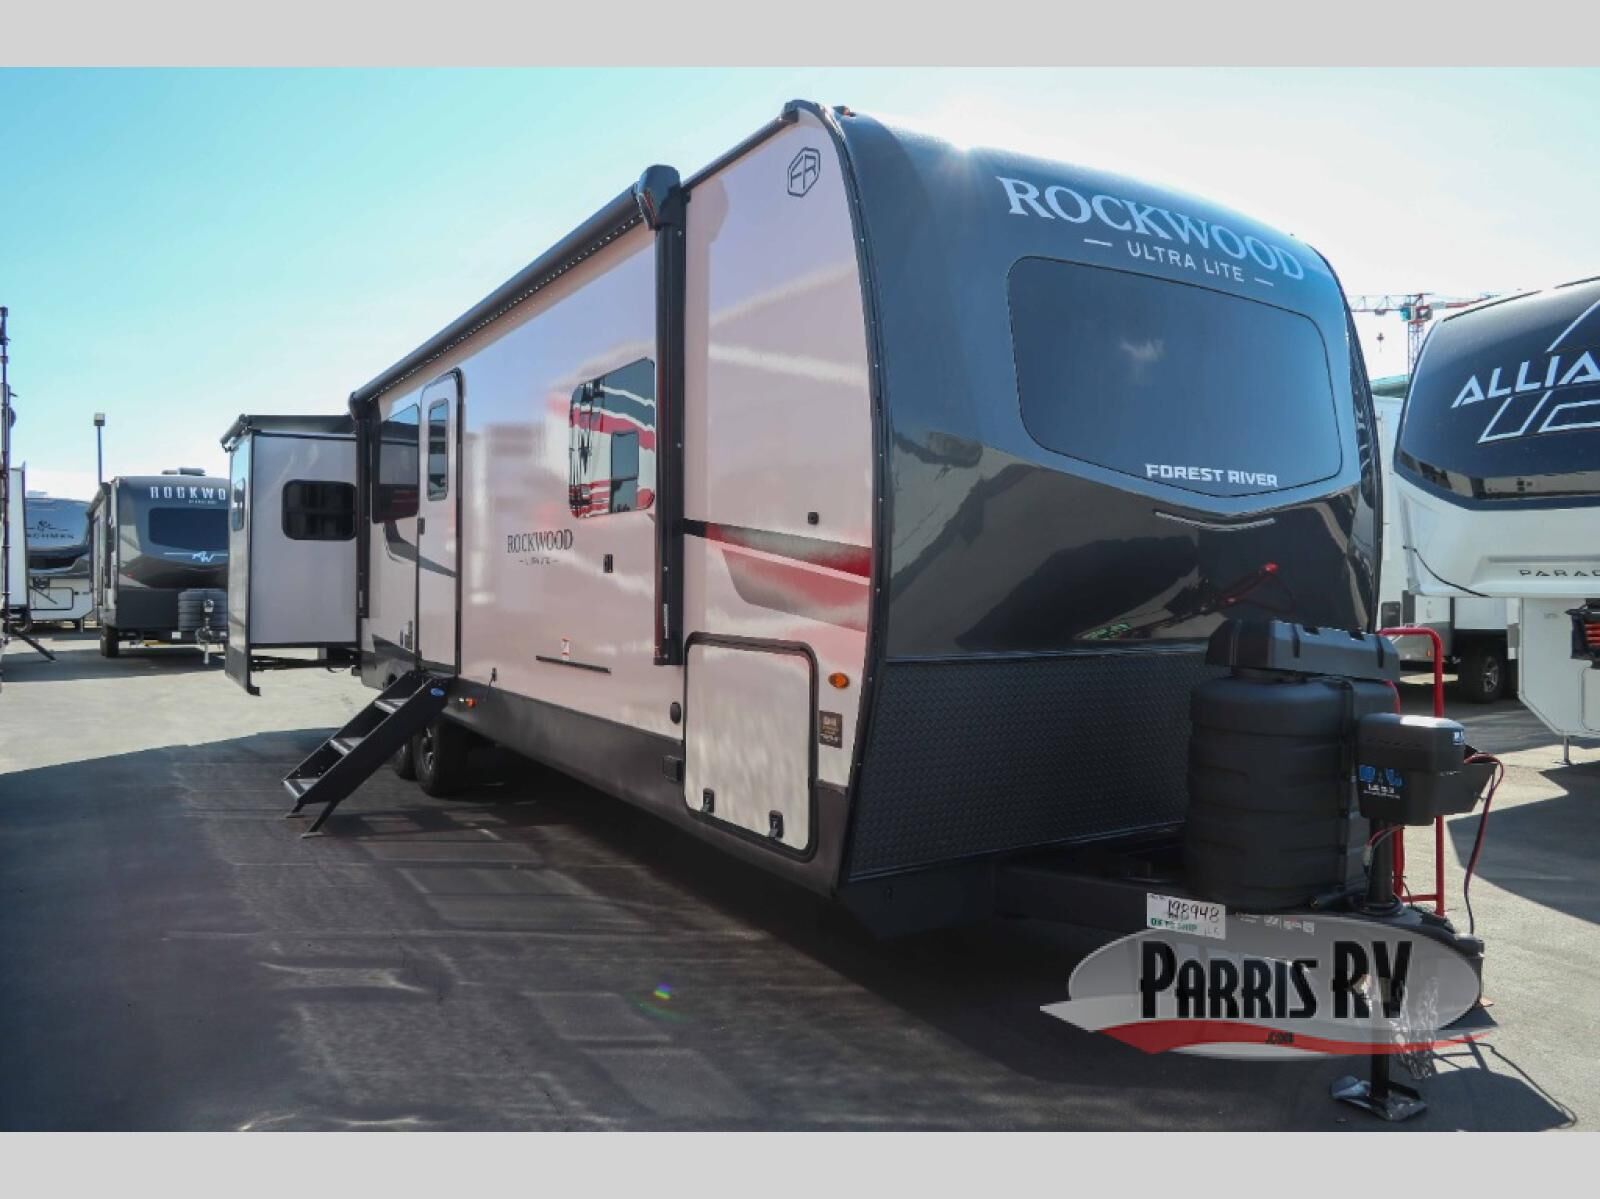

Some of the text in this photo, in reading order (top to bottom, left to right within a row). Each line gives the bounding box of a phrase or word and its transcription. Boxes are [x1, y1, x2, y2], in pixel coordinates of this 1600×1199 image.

[995, 176, 1305, 281] ROCKWOOD
[1127, 240, 1245, 283] ULTRA LITE
[1145, 463, 1279, 488] FOREST RIVER
[507, 529, 575, 554] ROCKWOOD
